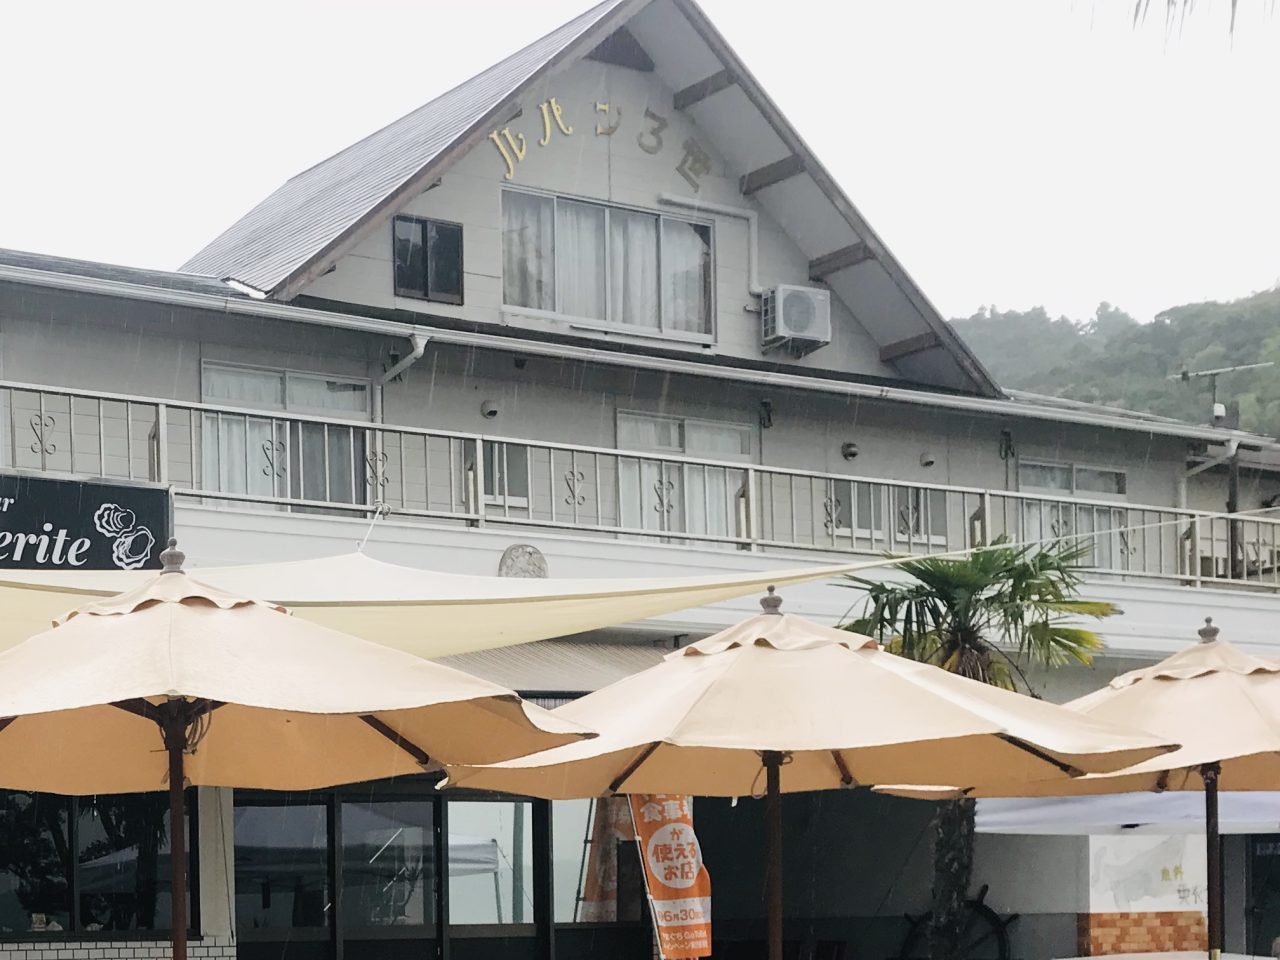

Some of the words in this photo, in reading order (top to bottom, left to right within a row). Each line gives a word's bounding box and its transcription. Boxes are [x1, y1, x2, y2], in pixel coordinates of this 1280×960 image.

[670, 827, 684, 841] が
[652, 842, 697, 863] 使える
[664, 862, 695, 880] お店
